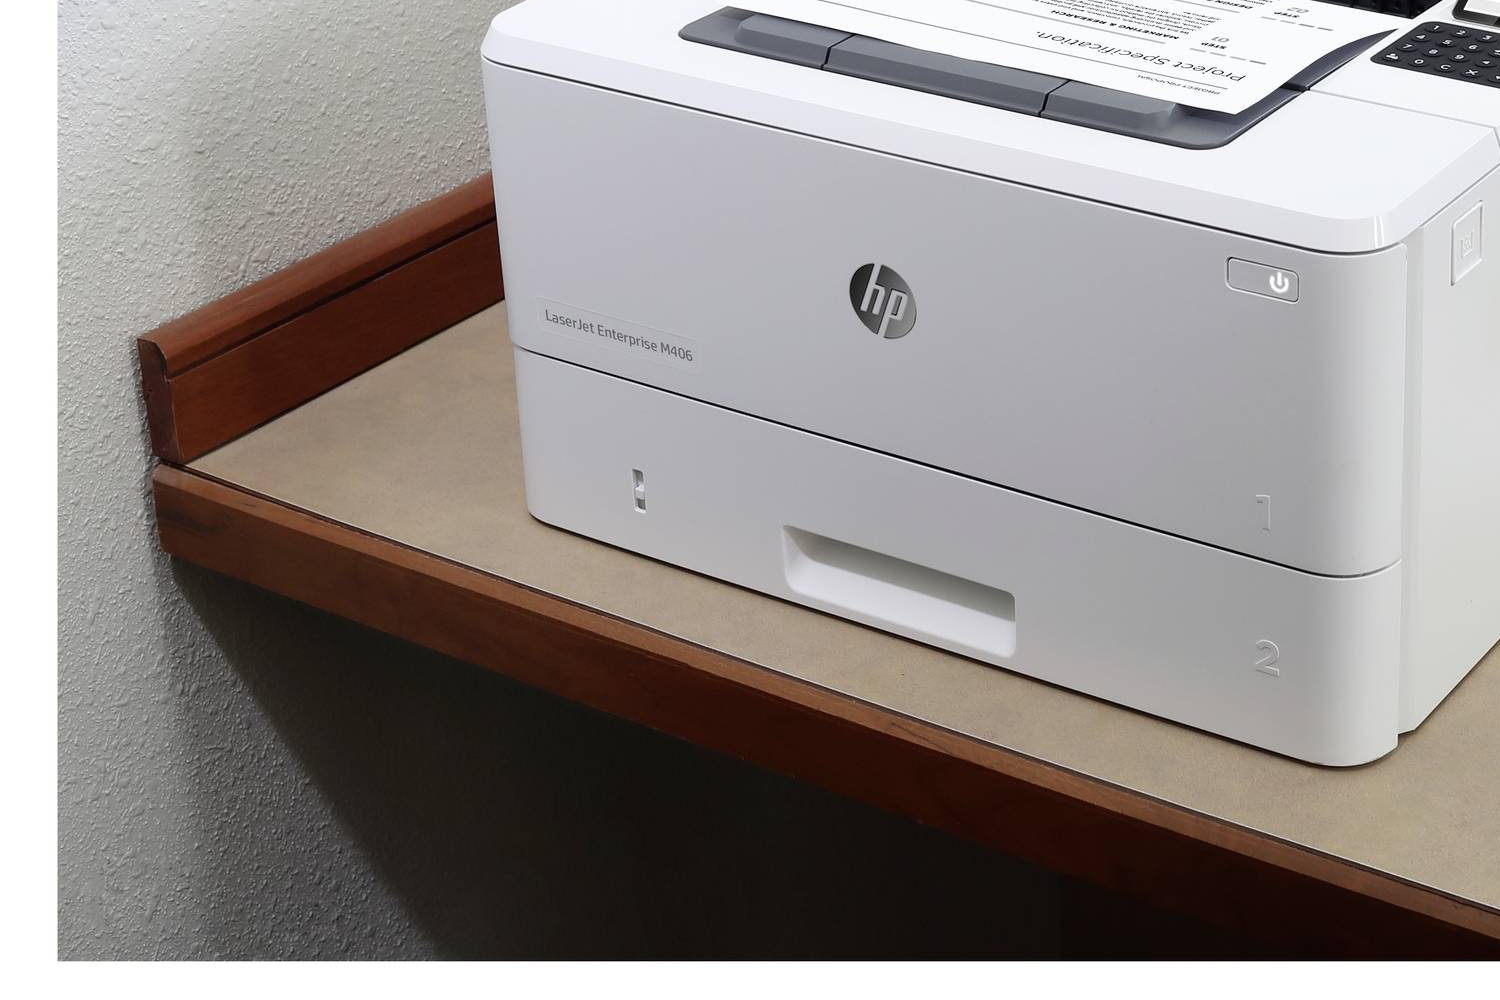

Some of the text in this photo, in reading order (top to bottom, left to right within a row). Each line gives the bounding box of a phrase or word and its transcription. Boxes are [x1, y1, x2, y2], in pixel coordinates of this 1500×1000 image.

[1214, 0, 1253, 9] DESIGN
[1051, 10, 1179, 40] MARKETING RESEARCH
[1037, 31, 1246, 82] Project Specification.
[1201, 42, 1227, 50] STEP
[860, 263, 908, 339] hp
[545, 309, 693, 362] LaserJet Enterprise M406
[1255, 639, 1280, 678] 2
